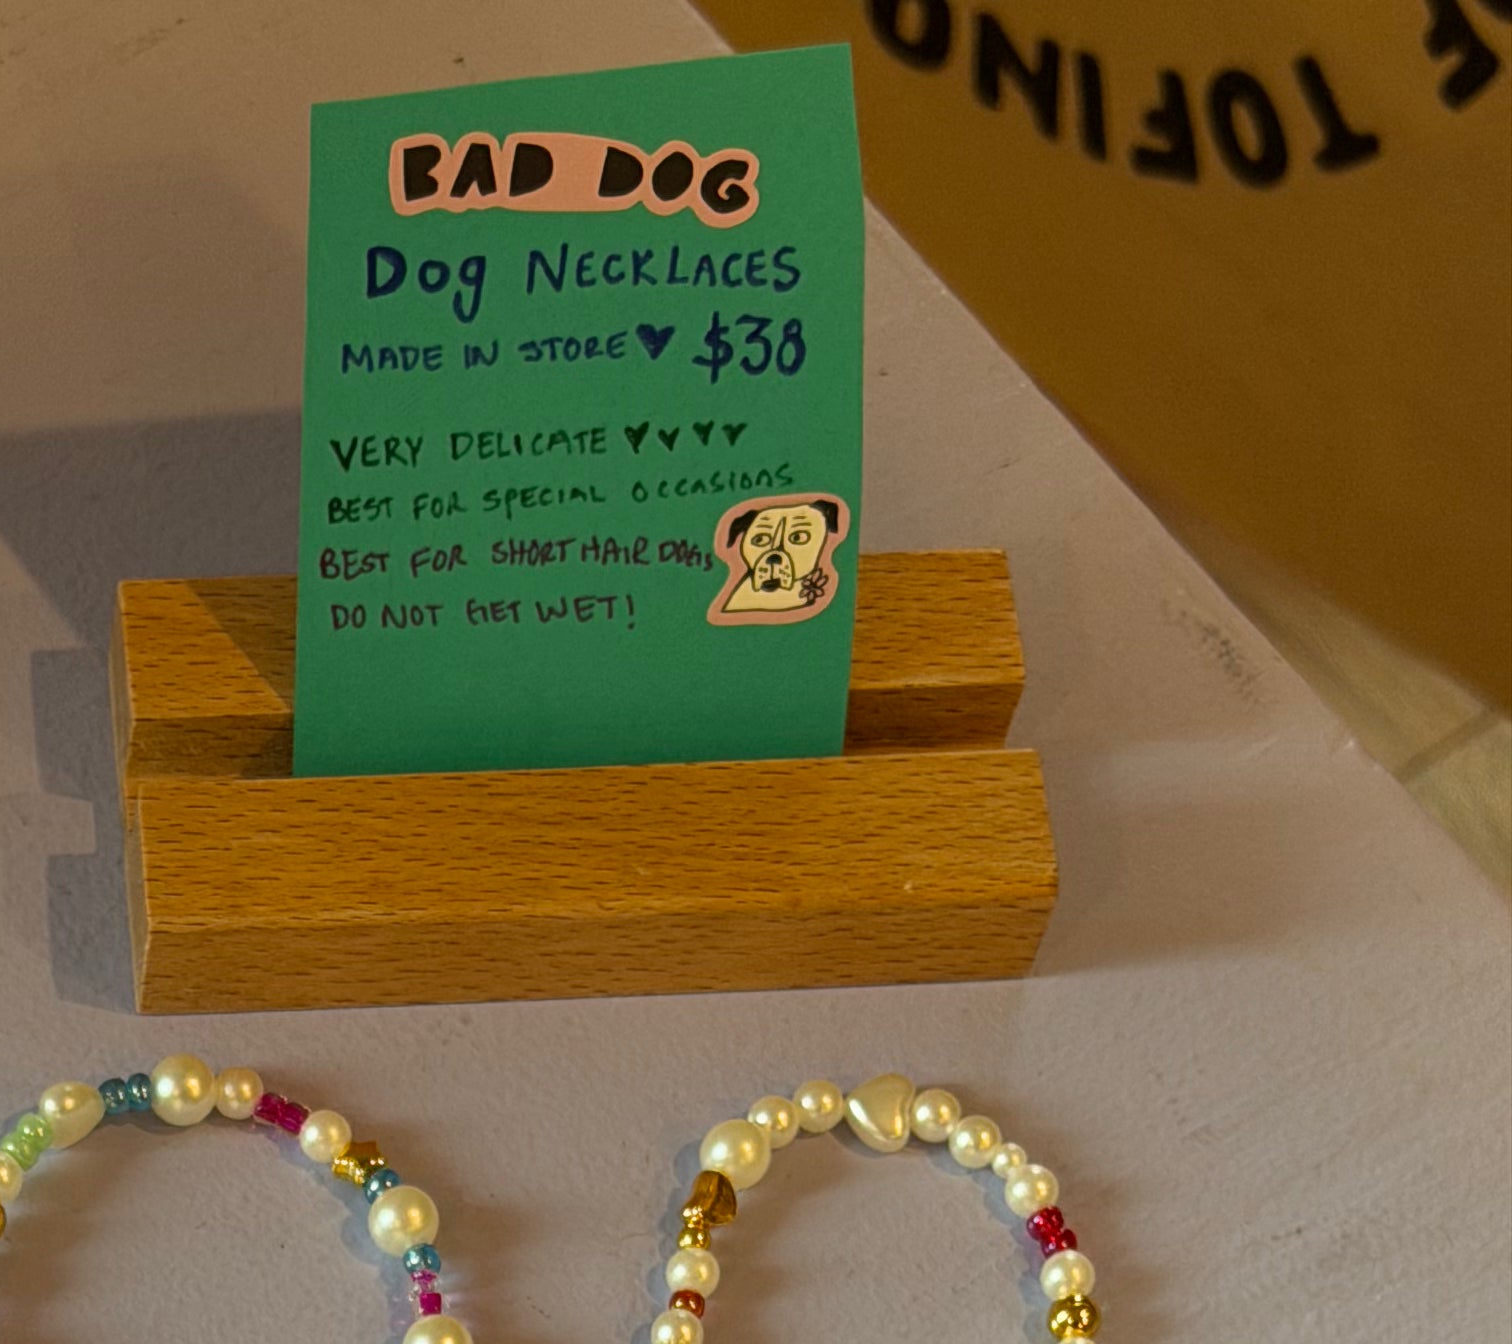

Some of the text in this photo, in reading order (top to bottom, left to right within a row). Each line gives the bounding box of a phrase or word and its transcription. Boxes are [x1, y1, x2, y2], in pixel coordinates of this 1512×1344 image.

[864, 0, 1512, 190] F TOFINO
[402, 141, 752, 215] BAD DOG
[365, 243, 802, 323] Dog NECKLACES
[340, 310, 807, 385] MADE IN STORE $38
[329, 426, 608, 472] VERY DELICATE
[326, 462, 794, 525] BEST FOR SPECIAL OCCASIONS
[319, 546, 390, 582] BEST
[409, 545, 468, 578] FOR
[330, 593, 637, 631] DO NOT GET WET!
